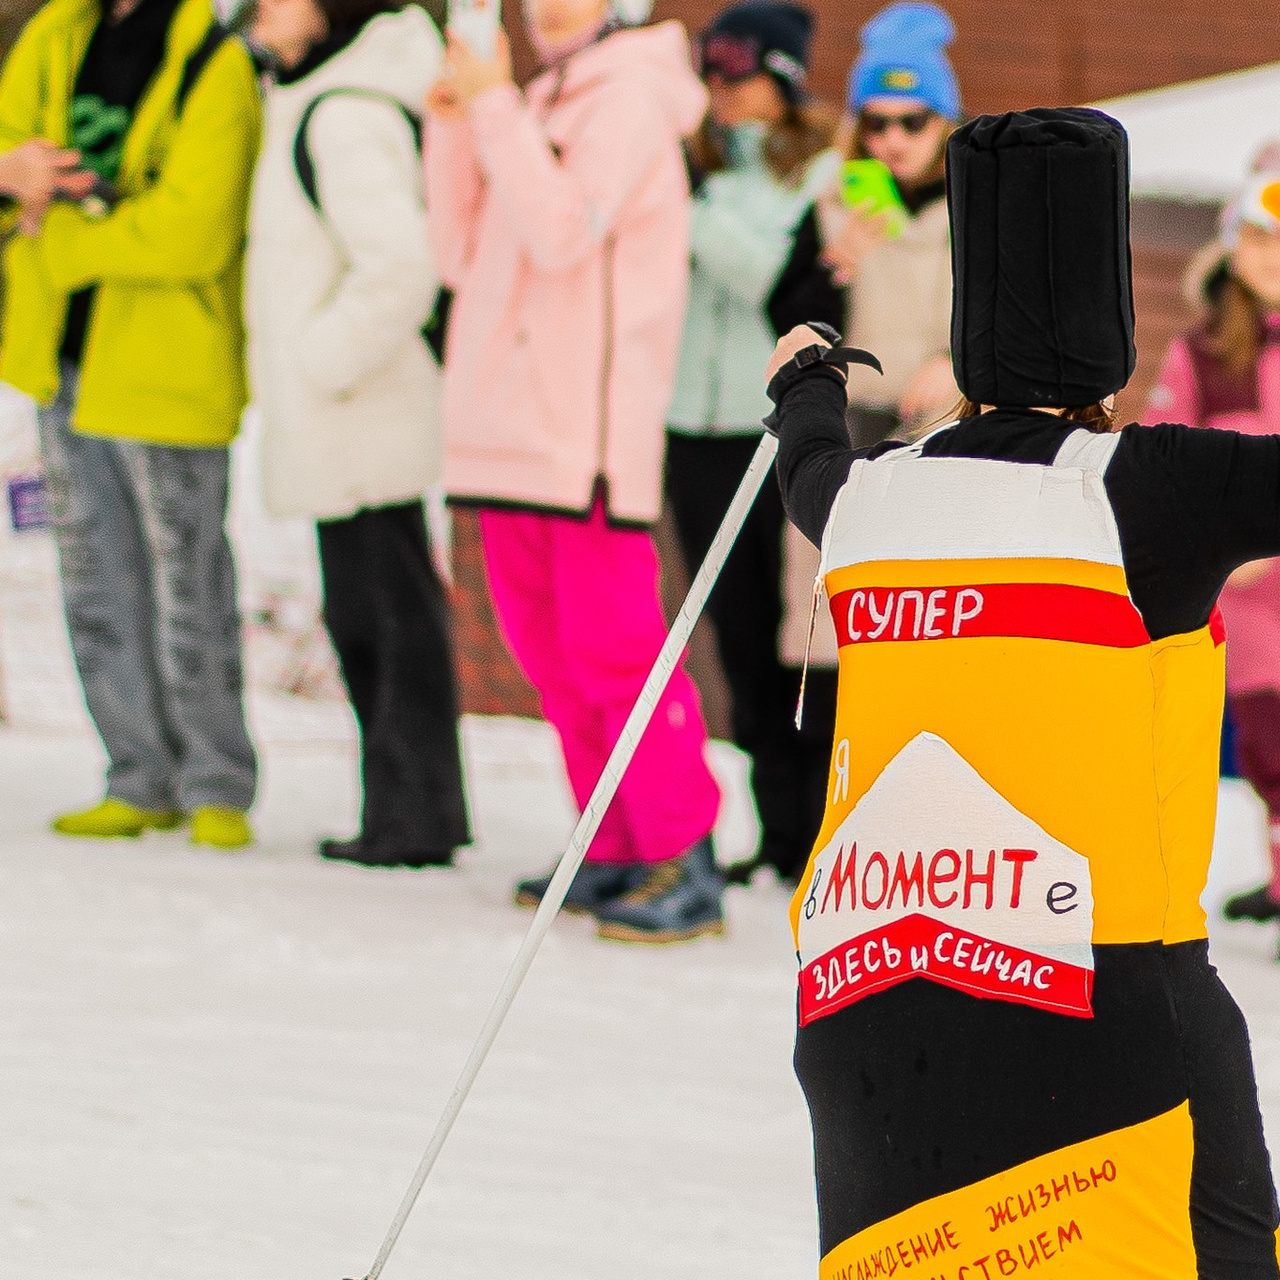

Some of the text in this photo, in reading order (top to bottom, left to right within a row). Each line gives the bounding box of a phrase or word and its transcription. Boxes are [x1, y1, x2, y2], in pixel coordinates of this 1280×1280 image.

[847, 588, 985, 640] СУПЕР
[832, 738, 850, 805] Я
[812, 937, 901, 1000] ЗДЕСЬ
[933, 931, 1054, 990] СЕЙЧАС
[984, 1158, 1118, 1233] ЖИЗНЬЮ
